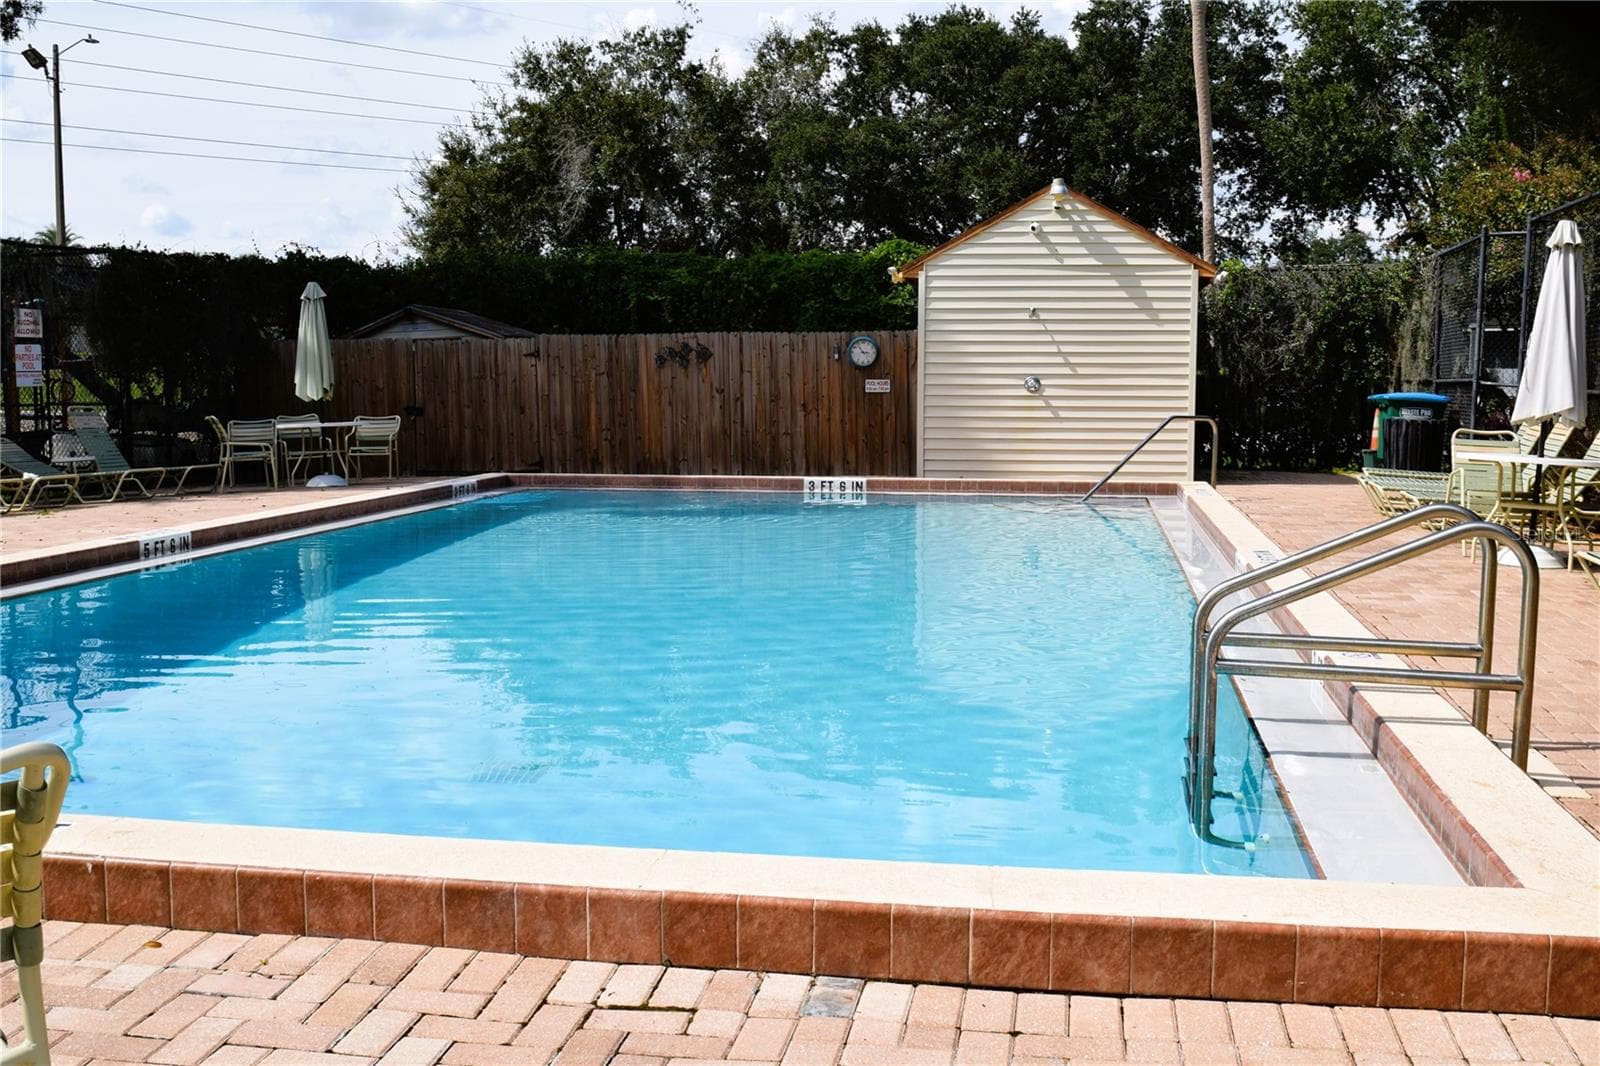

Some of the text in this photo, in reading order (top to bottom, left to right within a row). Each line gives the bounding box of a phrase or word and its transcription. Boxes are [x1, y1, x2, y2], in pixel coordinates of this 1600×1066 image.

[808, 480, 815, 491] 3
[840, 481, 846, 491] 6
[851, 481, 863, 491] IN
[143, 535, 189, 558] 5 FT 6 IN
